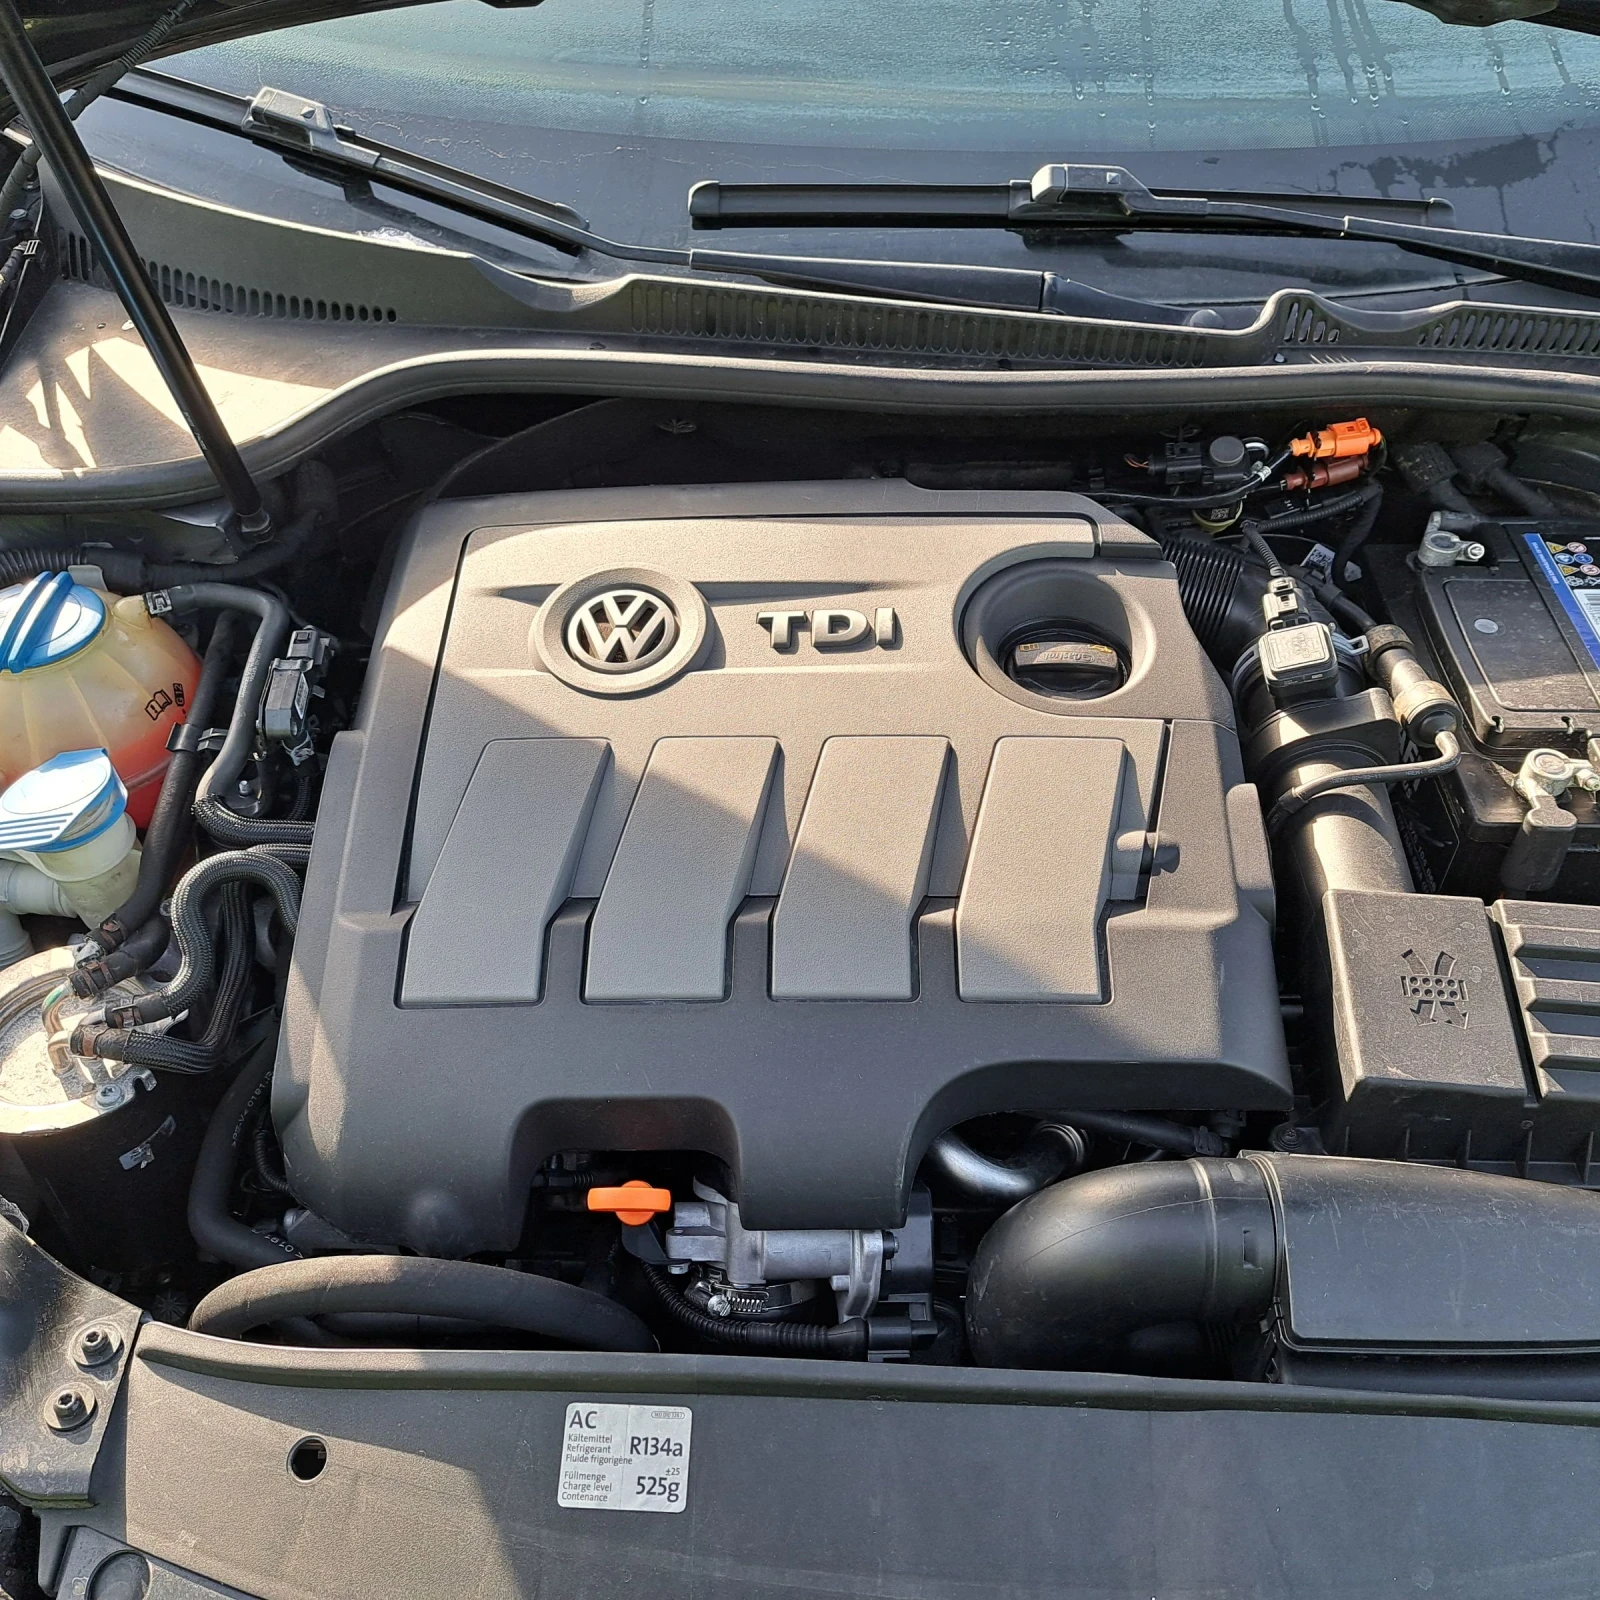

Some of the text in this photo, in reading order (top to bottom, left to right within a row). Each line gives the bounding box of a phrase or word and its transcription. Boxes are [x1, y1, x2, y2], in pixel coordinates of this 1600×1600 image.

[567, 589, 677, 671] VW
[756, 607, 898, 649] TDI
[569, 1410, 597, 1429] AC
[568, 1433, 613, 1444] Kältemittel
[566, 1444, 611, 1454] Refrigerant
[629, 1436, 683, 1457] R134a
[565, 1453, 633, 1466] Fluide frigorigène
[564, 1471, 607, 1483] Füllmenge
[562, 1482, 612, 1492] Charge level
[635, 1475, 681, 1503] 525g
[561, 1492, 608, 1502] Contenance
